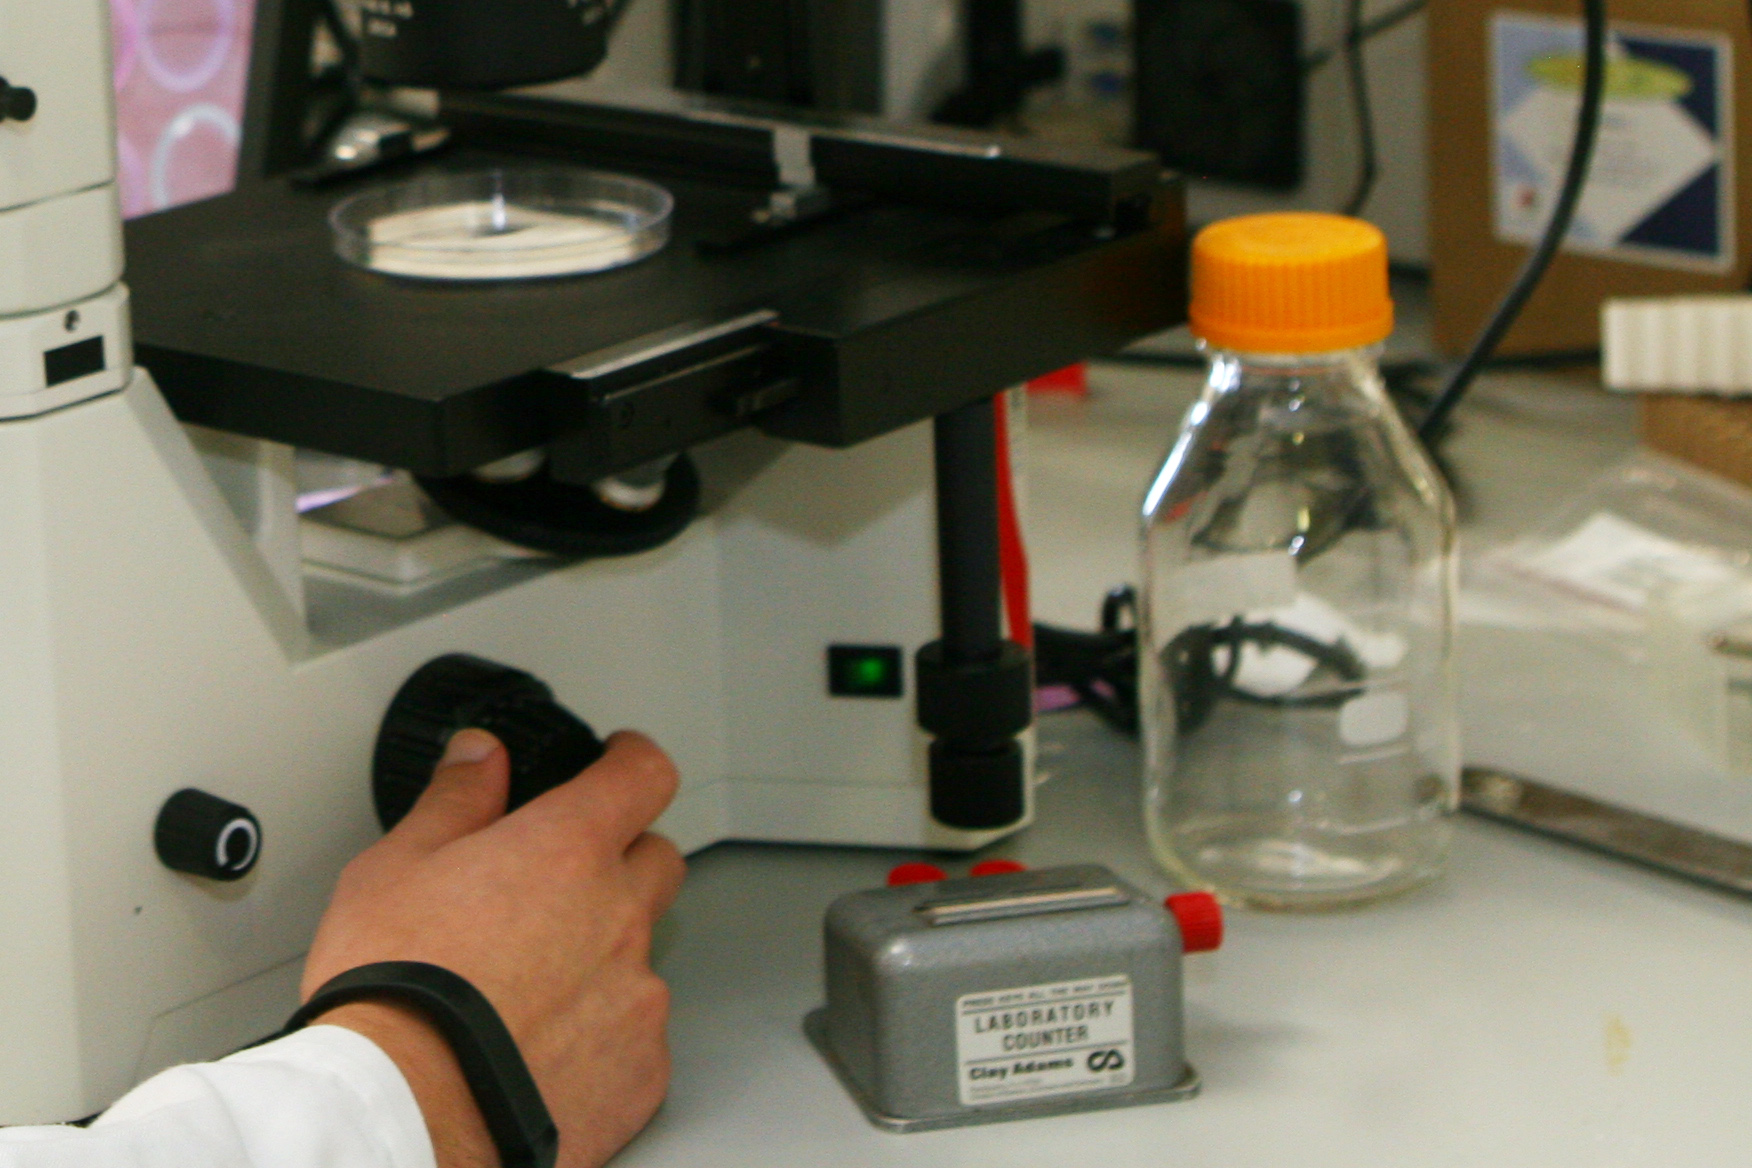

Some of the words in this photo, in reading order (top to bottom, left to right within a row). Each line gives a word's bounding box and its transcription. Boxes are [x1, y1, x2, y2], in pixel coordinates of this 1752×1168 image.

[974, 1000, 1115, 1034] LABORATORY
[1003, 1024, 1089, 1051] COUNTER
[970, 1066, 1008, 1080] Clay
[1013, 1057, 1074, 1074] Adams
